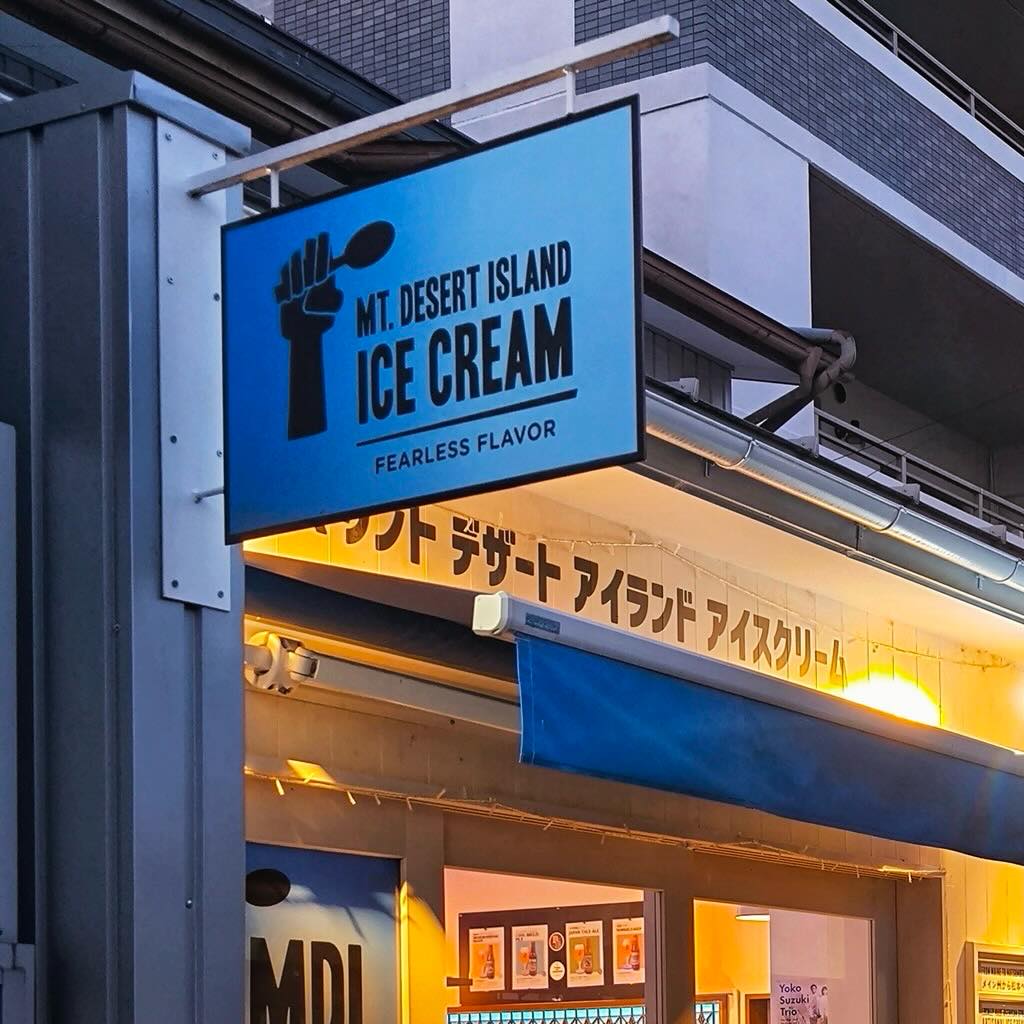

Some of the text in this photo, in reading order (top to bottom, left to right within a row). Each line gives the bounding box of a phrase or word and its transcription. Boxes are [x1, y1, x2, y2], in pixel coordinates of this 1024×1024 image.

[356, 240, 572, 338] MT. DESERT ISLAND
[356, 296, 574, 425] ICE CREAM
[375, 419, 557, 475] FEARLESS FLAVOR
[452, 515, 561, 603] デザート
[573, 556, 697, 644] アイランド
[706, 598, 846, 691] アイスクリーム
[779, 983, 802, 993] Yoko
[779, 994, 810, 1005] Suzuki
[780, 1006, 798, 1016] Trio
